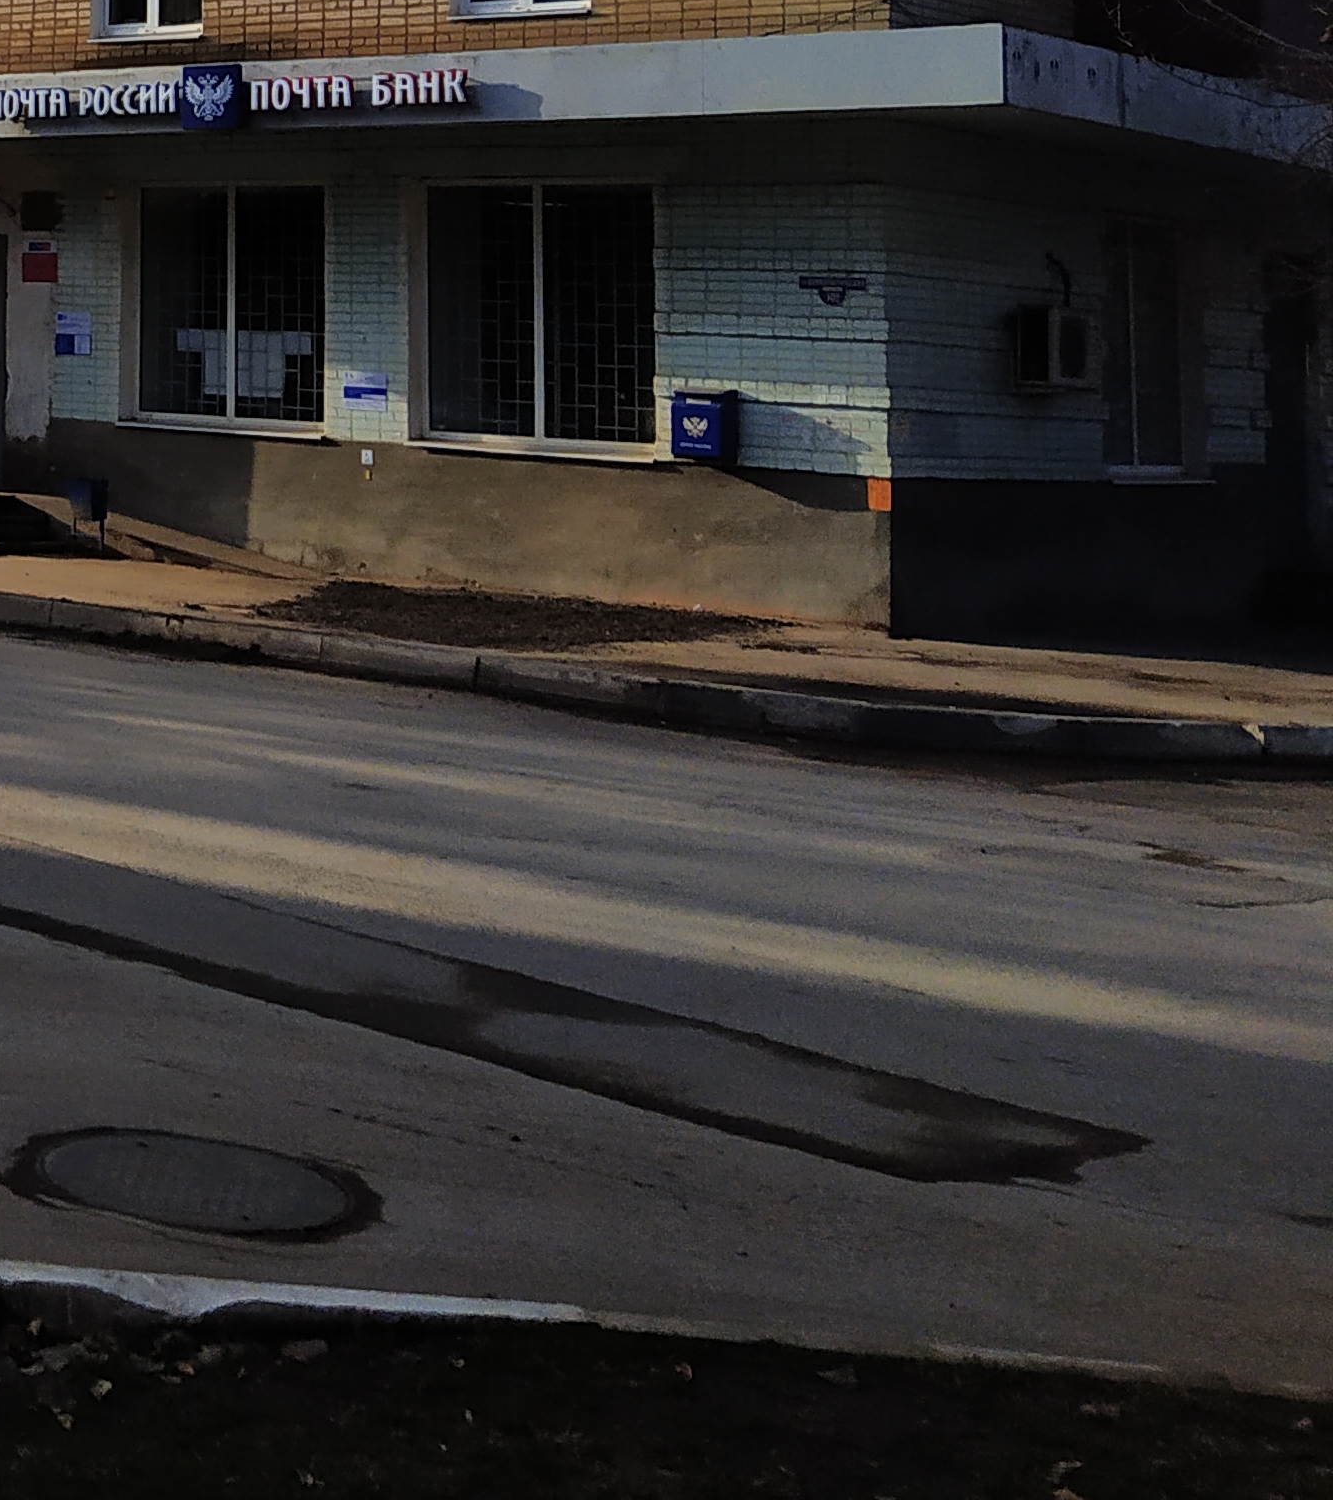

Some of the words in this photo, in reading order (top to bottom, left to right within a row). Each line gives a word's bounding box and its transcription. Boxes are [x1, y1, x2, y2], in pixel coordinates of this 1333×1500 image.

[79, 81, 178, 117] РОССИИ
[250, 75, 354, 111] ПОЧТА
[371, 69, 468, 107] БАНК
